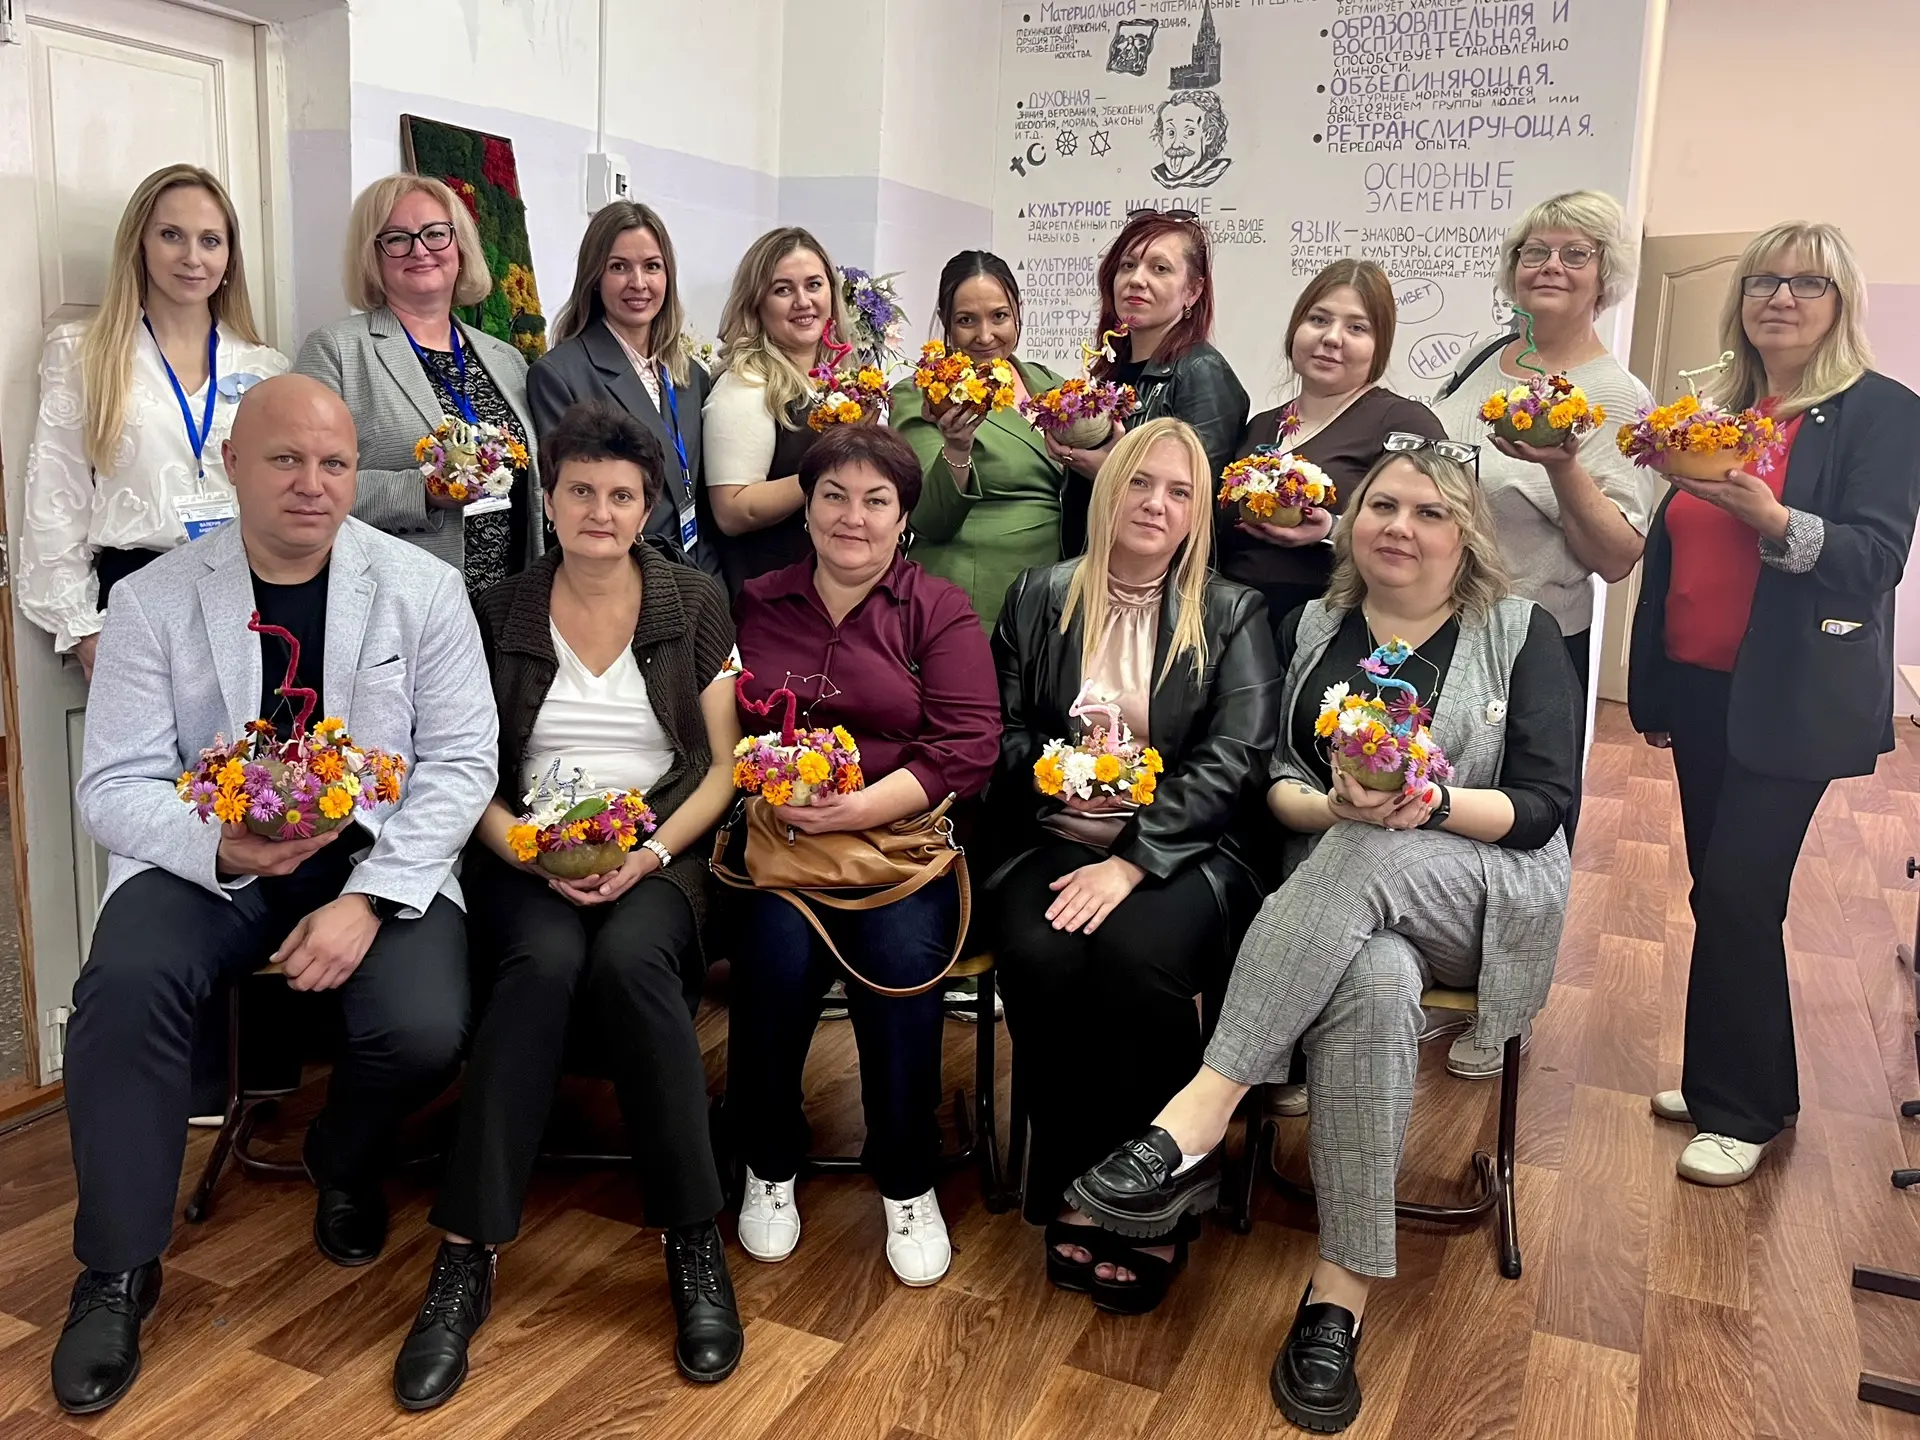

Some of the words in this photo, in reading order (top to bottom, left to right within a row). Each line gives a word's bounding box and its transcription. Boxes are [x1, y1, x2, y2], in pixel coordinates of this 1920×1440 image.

[1331, 2, 1534, 40] ОБРАЗОВАТЕЛЬНАЯ
[1333, 48, 1445, 68] СПОСОБСТВУЕТ
[1455, 38, 1569, 58] СТАНОВЛЕНИЮ
[1026, 89, 1090, 109] ДУХОВНАЯ
[1327, 101, 1422, 115] ДОСТОЯНИЕМ
[1432, 98, 1483, 111] ГРУППЫ
[1549, 94, 1580, 104] ИЛИ
[1329, 92, 1406, 106] КУЛЬТУРНЫЕ
[1415, 89, 1463, 101] НОРМЫ
[1471, 86, 1534, 99] ЯВЛЯЮТСЯ
[1102, 116, 1144, 127] ЗАКОНЫ
[1328, 139, 1402, 153] ПЕРЕДАЧА
[1415, 138, 1471, 151] ОПЫТА.
[1364, 160, 1515, 191] ОСНОВНЫЕ
[1027, 200, 1112, 218] КУЛЬТУРНОЕ
[1365, 189, 1512, 214] ЭЛЕМЕНТЫ
[1289, 220, 1342, 243] ЯЗЫК
[1290, 244, 1352, 257] ЭЛЕМЕНТ
[1433, 244, 1500, 258] СИСТЕМА
[1027, 256, 1094, 272] КУЛЬТУРНОЕ
[1387, 269, 1467, 278] ВОСПРИНИМАЕТ
[1391, 259, 1455, 271] БЛАГОДАРЯ
[1464, 259, 1496, 270] ЕМУ
[1026, 337, 1064, 347] ОДНОГО
[1026, 349, 1049, 360] ПРИ
[1054, 349, 1069, 360] ИХ
[1411, 340, 1461, 376] Hello
